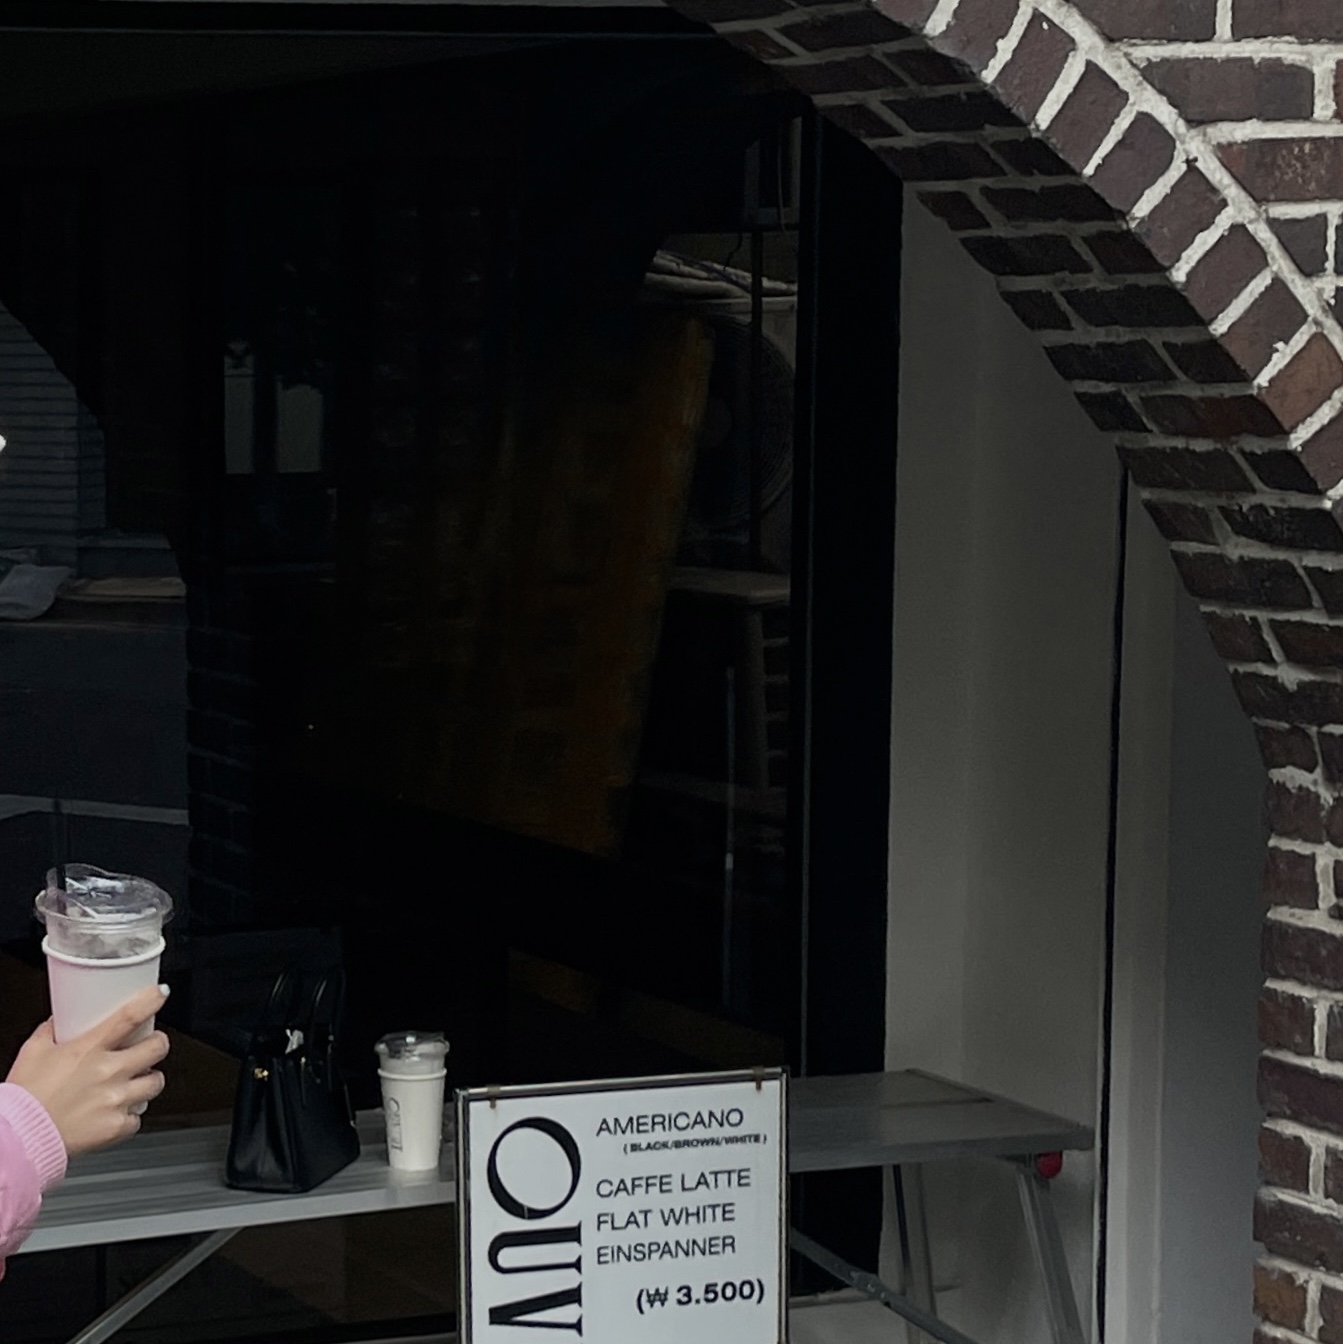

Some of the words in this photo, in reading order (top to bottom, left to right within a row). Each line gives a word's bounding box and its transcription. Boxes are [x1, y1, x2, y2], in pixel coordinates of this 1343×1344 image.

[596, 1108, 744, 1137] AMERICANO
[596, 1174, 673, 1198] CAFFE
[680, 1168, 751, 1192] LATTE
[596, 1210, 652, 1232] FLAT
[660, 1203, 735, 1227] WHITE
[596, 1236, 736, 1265] EINSPANNER
